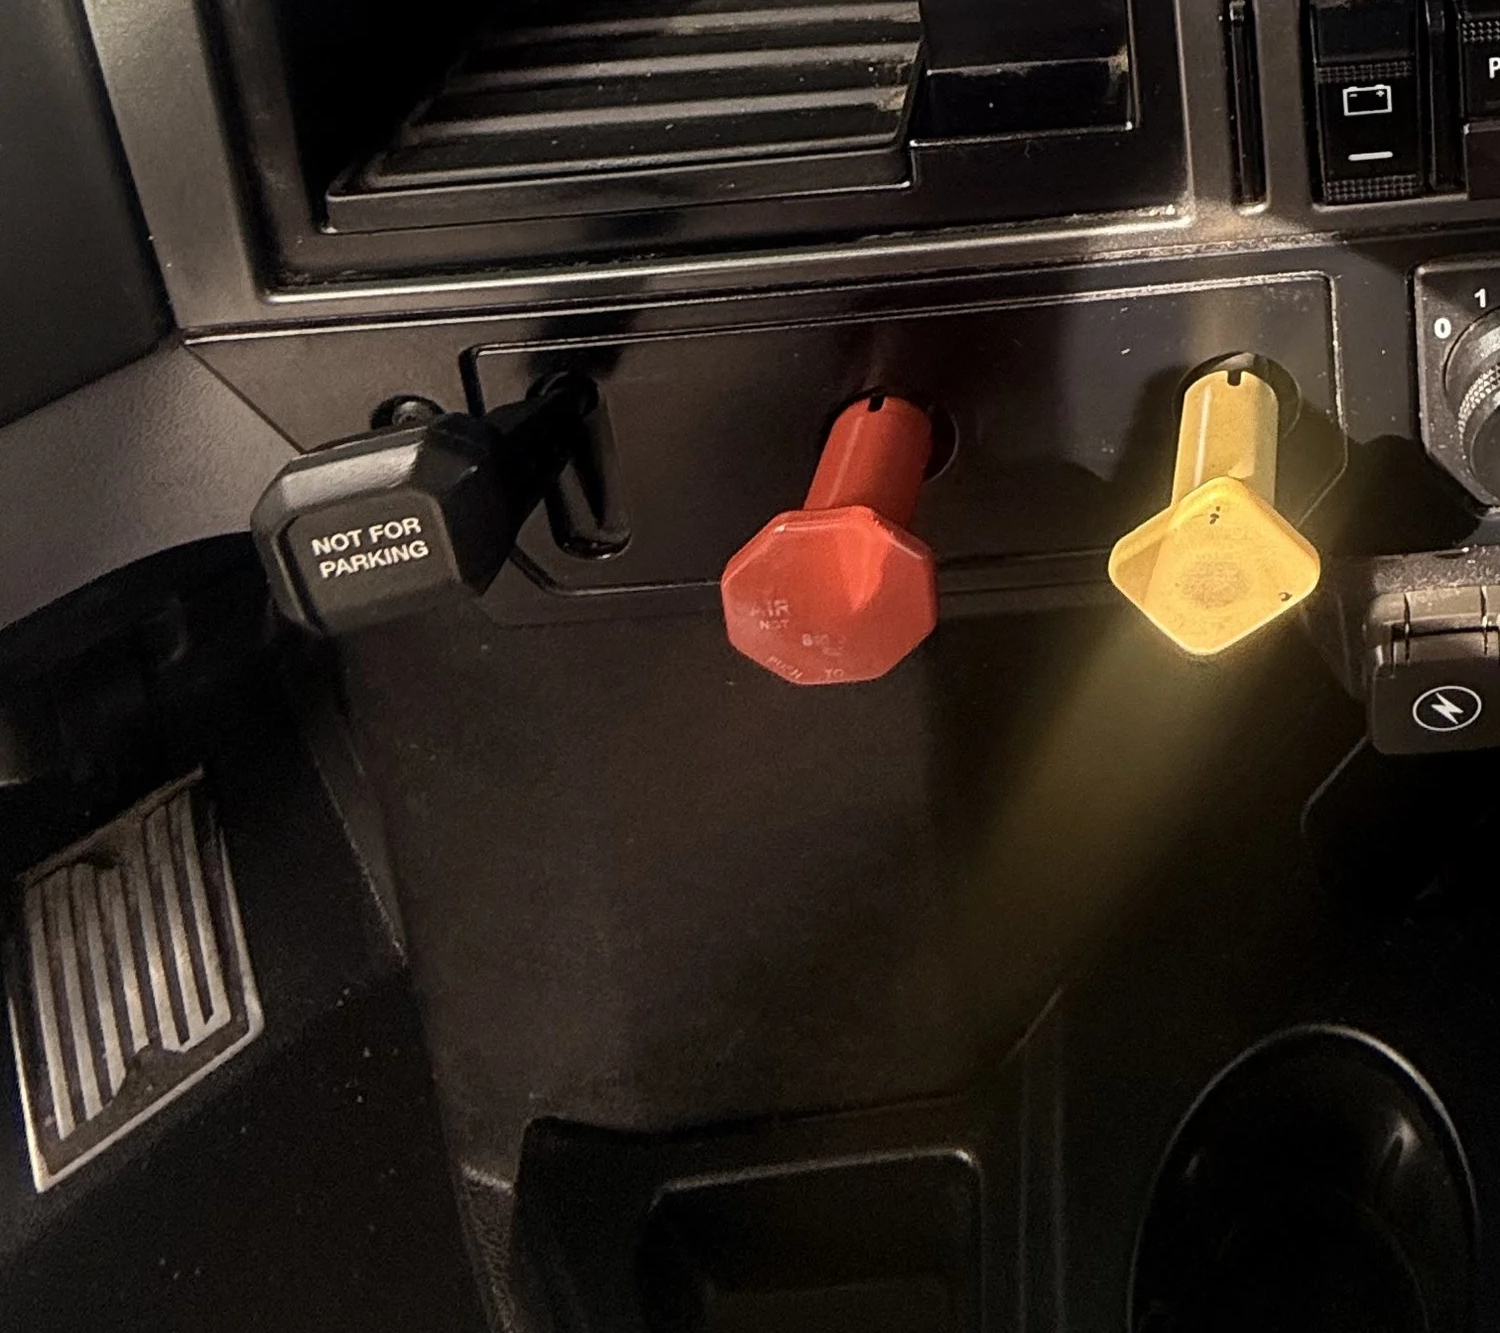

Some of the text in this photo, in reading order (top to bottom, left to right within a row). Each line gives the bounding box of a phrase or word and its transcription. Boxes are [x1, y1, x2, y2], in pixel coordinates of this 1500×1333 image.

[1473, 288, 1487, 309] 1
[1434, 317, 1452, 339] 0
[311, 517, 421, 556] NOT FOR
[319, 540, 429, 578] PARKING
